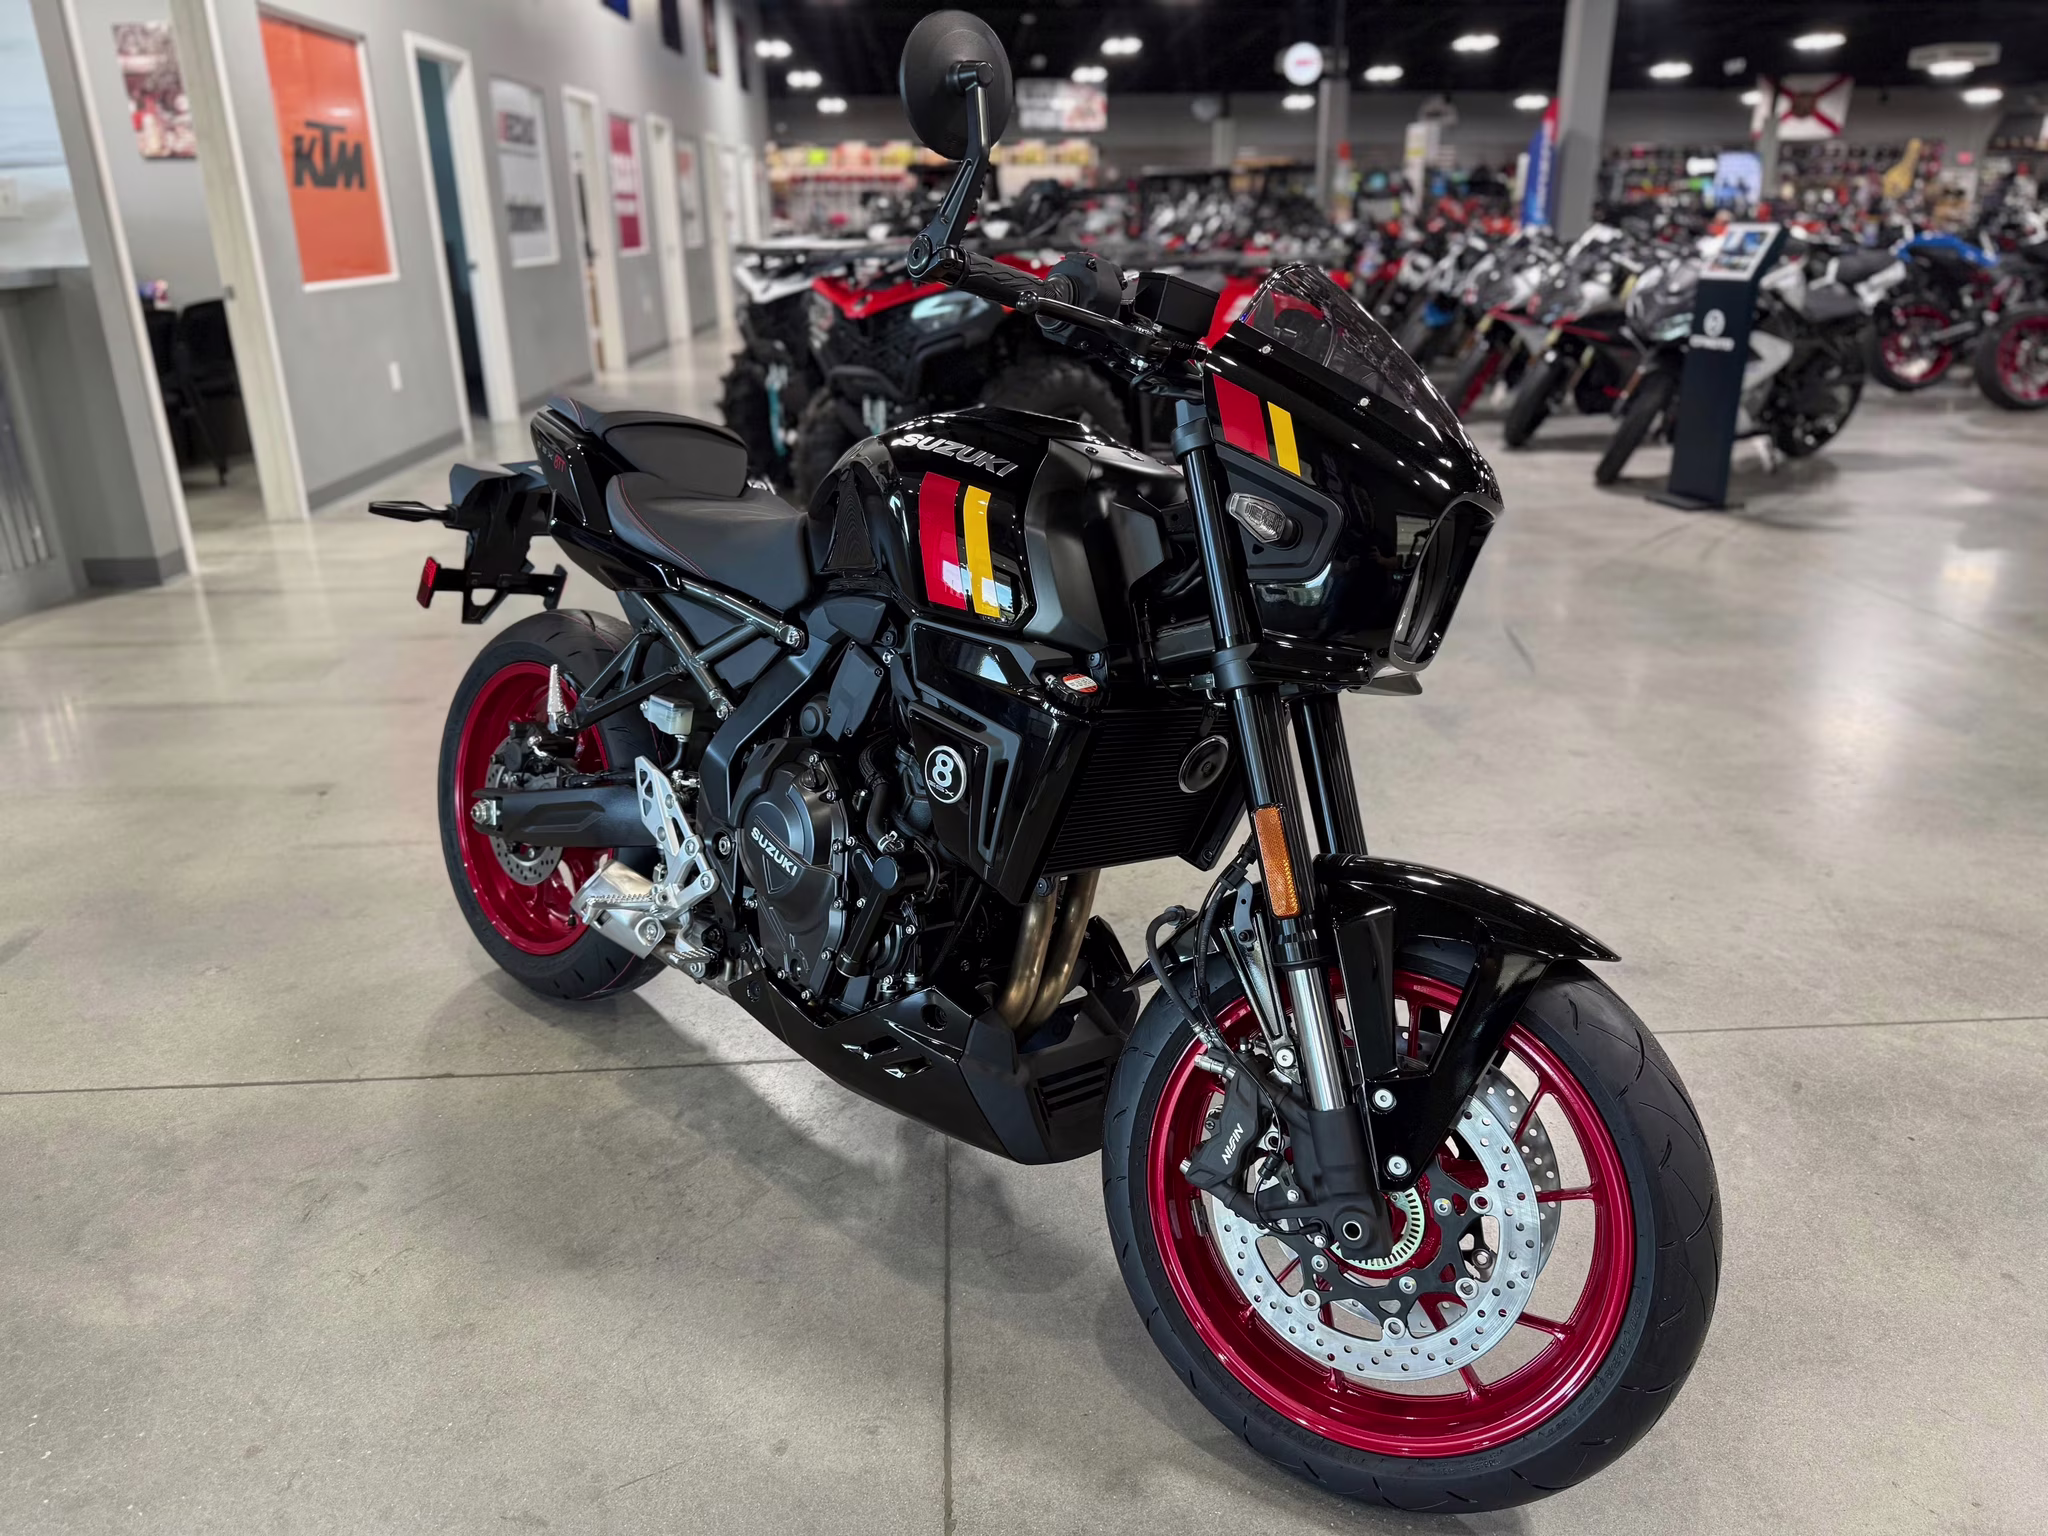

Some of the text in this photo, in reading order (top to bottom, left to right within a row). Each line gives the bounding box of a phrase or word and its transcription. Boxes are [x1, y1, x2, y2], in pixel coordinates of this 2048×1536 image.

[293, 120, 366, 190] KTM
[890, 433, 1019, 478] SUZUKI
[932, 753, 955, 788] 8
[751, 826, 798, 877] SUZUKI
[1221, 1122, 1244, 1165] NISSIN
